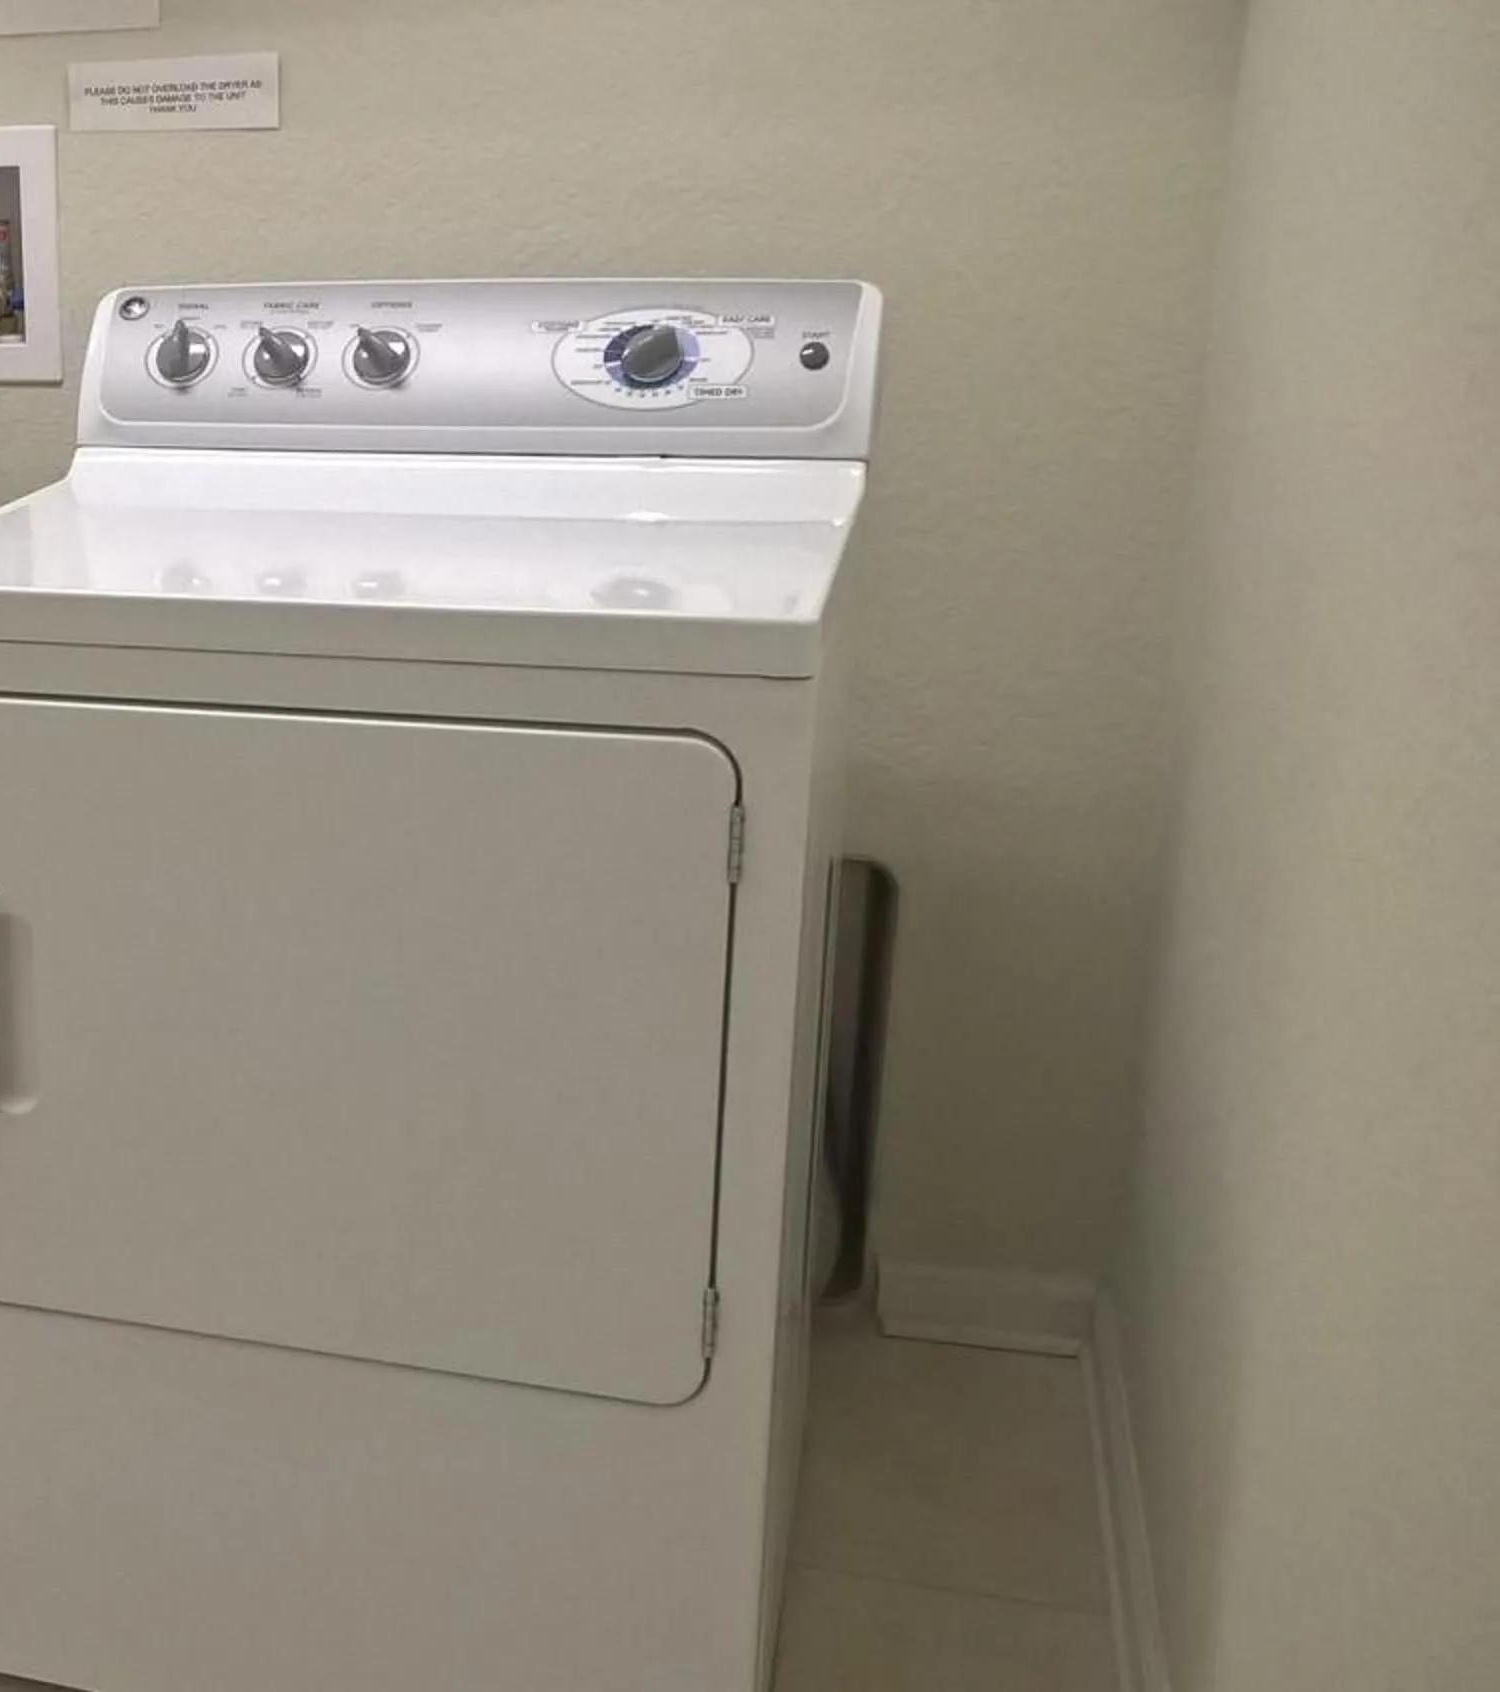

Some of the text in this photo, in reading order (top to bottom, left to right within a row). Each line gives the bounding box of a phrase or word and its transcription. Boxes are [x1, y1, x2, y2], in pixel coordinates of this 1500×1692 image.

[83, 86, 116, 97] PLEASE
[117, 85, 131, 95] DO
[132, 83, 150, 94] NOT
[152, 82, 198, 94] OVERLOAD
[200, 81, 216, 91] THE
[219, 80, 248, 91] DRYER
[100, 91, 247, 106] THIS CAUSES DAMAGE TO THE UNIT
[178, 104, 197, 113] YOU
